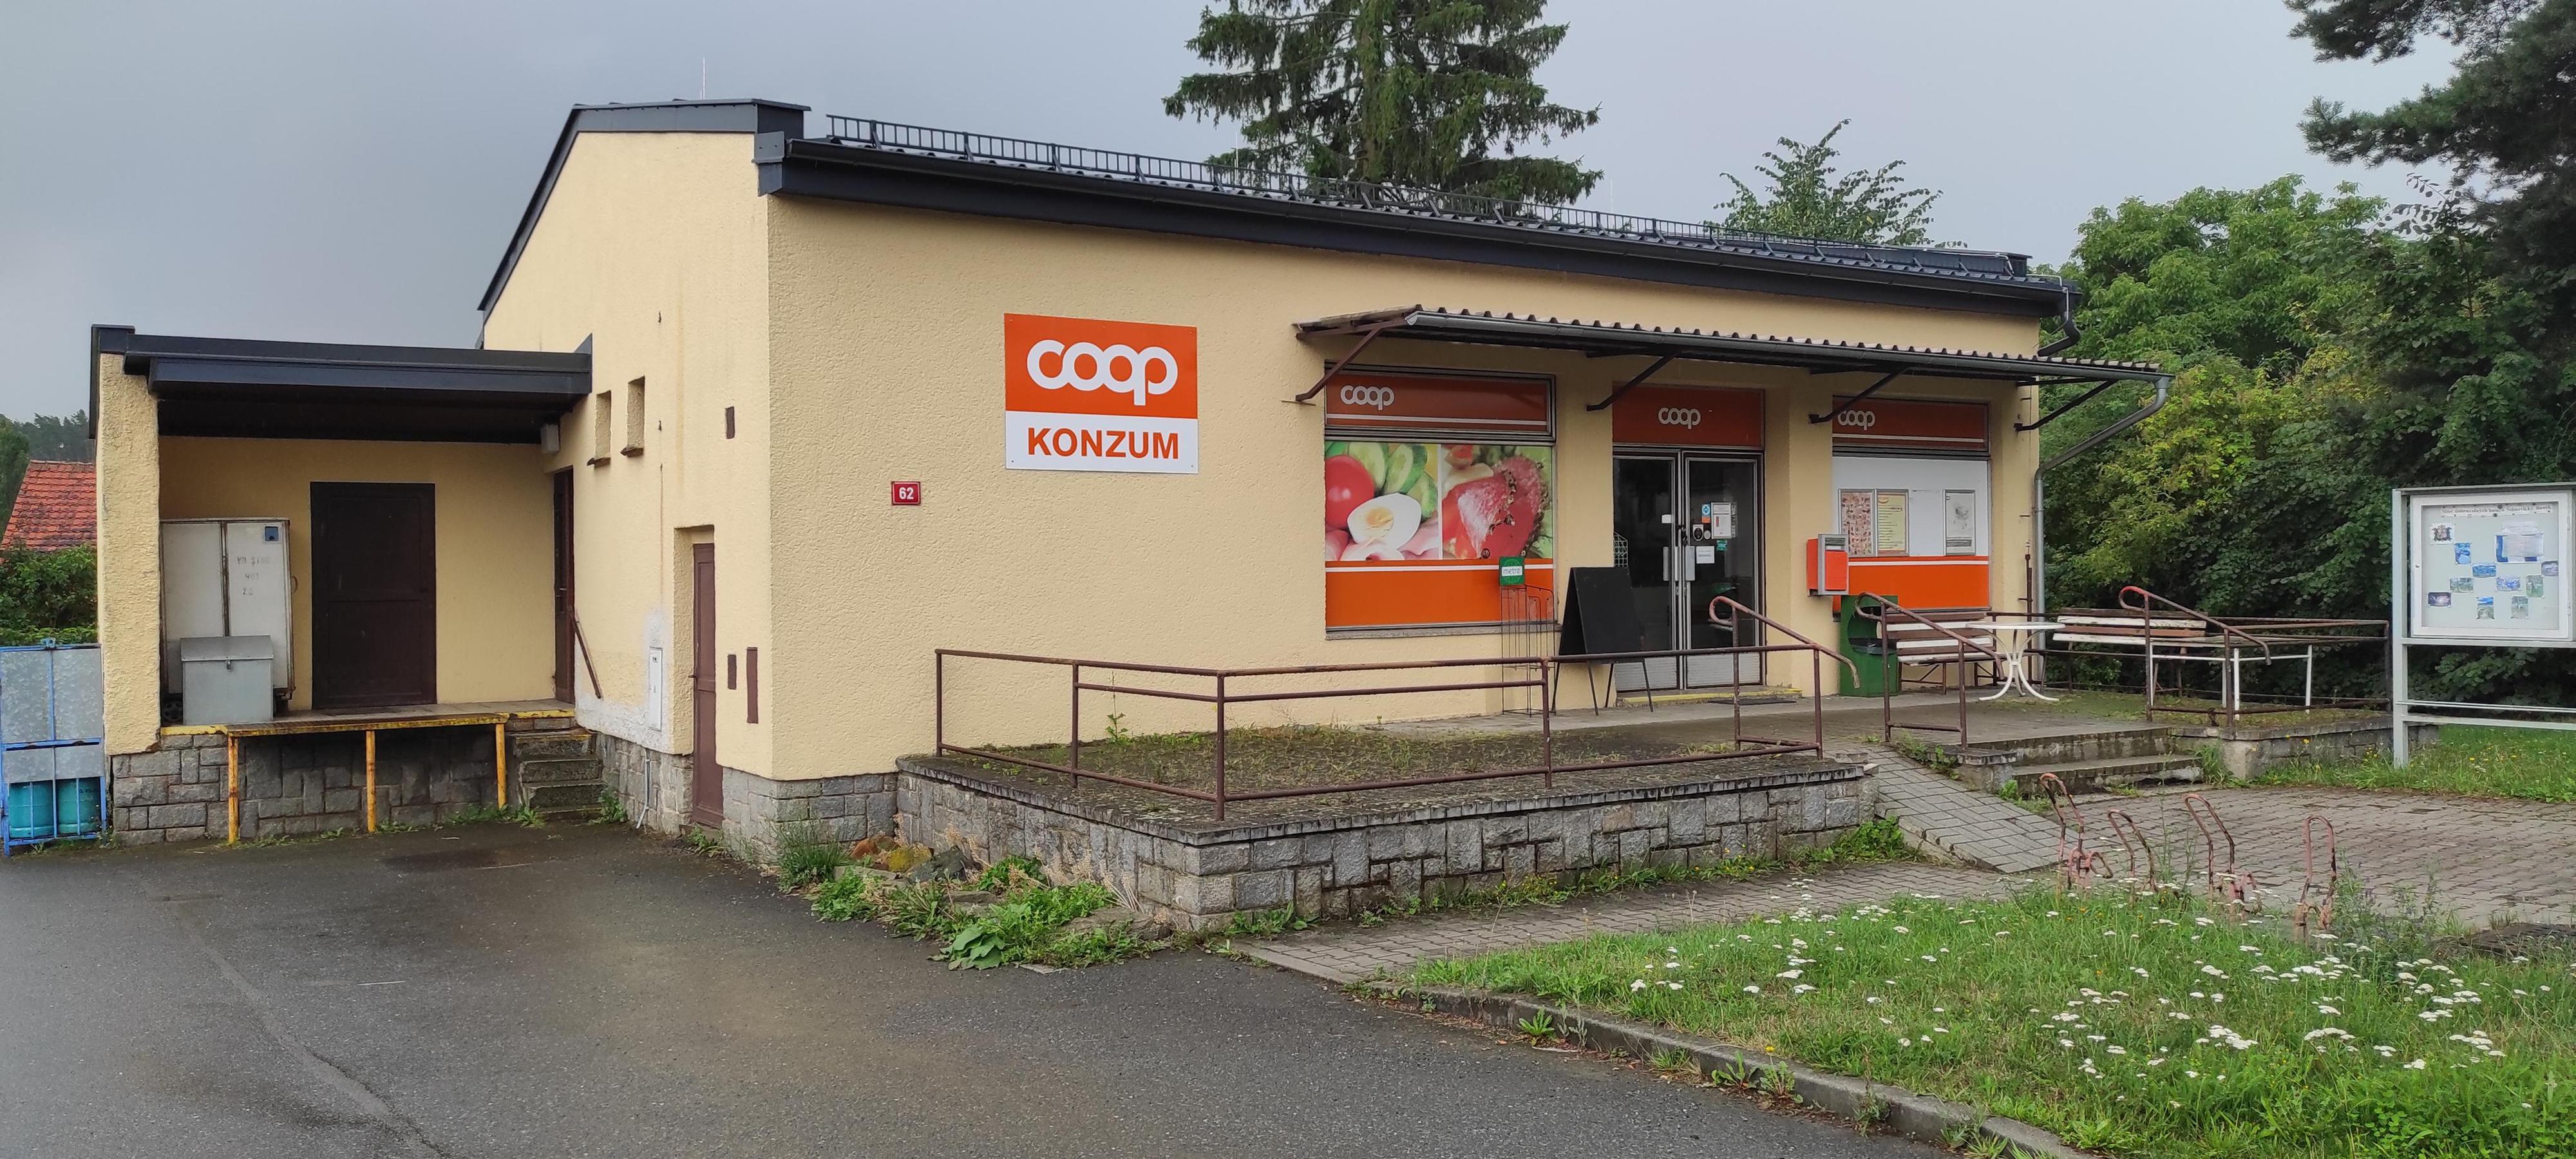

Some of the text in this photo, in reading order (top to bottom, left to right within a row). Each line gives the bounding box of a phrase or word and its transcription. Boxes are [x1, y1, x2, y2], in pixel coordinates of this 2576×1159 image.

[1027, 340, 1179, 406] coop
[1340, 385, 1394, 410] coop
[1658, 407, 1701, 430] coop
[1837, 410, 1875, 430] coop
[1028, 427, 1179, 459] KONZUM
[899, 486, 914, 499] 62
